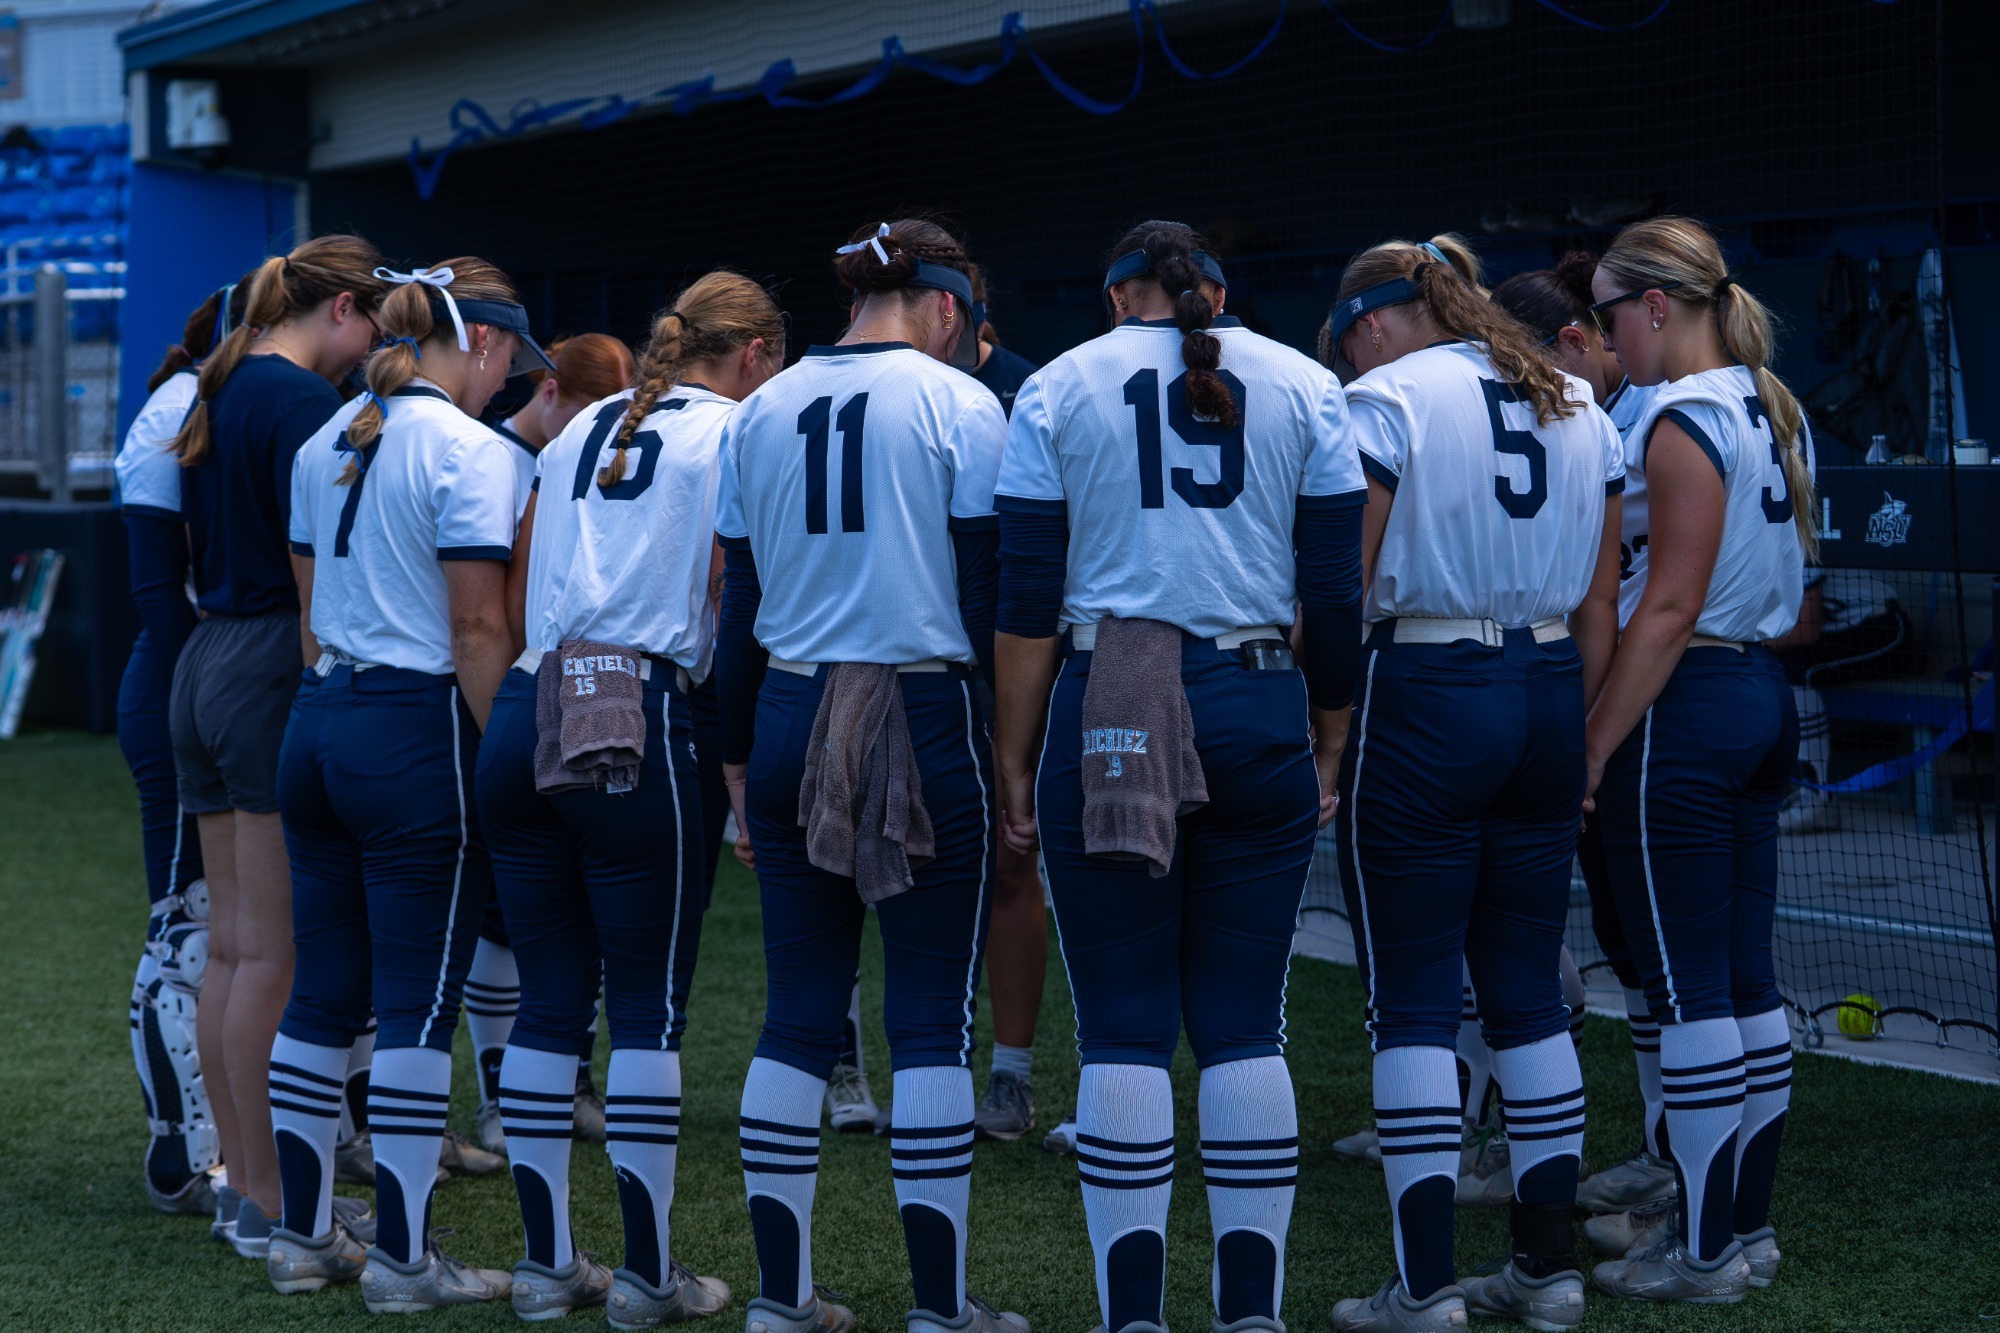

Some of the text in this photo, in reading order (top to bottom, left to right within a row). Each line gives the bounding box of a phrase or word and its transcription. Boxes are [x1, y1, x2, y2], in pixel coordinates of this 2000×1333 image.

[332, 430, 383, 557] 7
[571, 398, 690, 501] 15
[797, 391, 869, 534] 11
[1123, 368, 1246, 509] 19
[1478, 376, 1548, 519] 5
[575, 676, 596, 696] 15
[1105, 754, 1123, 777] 19
